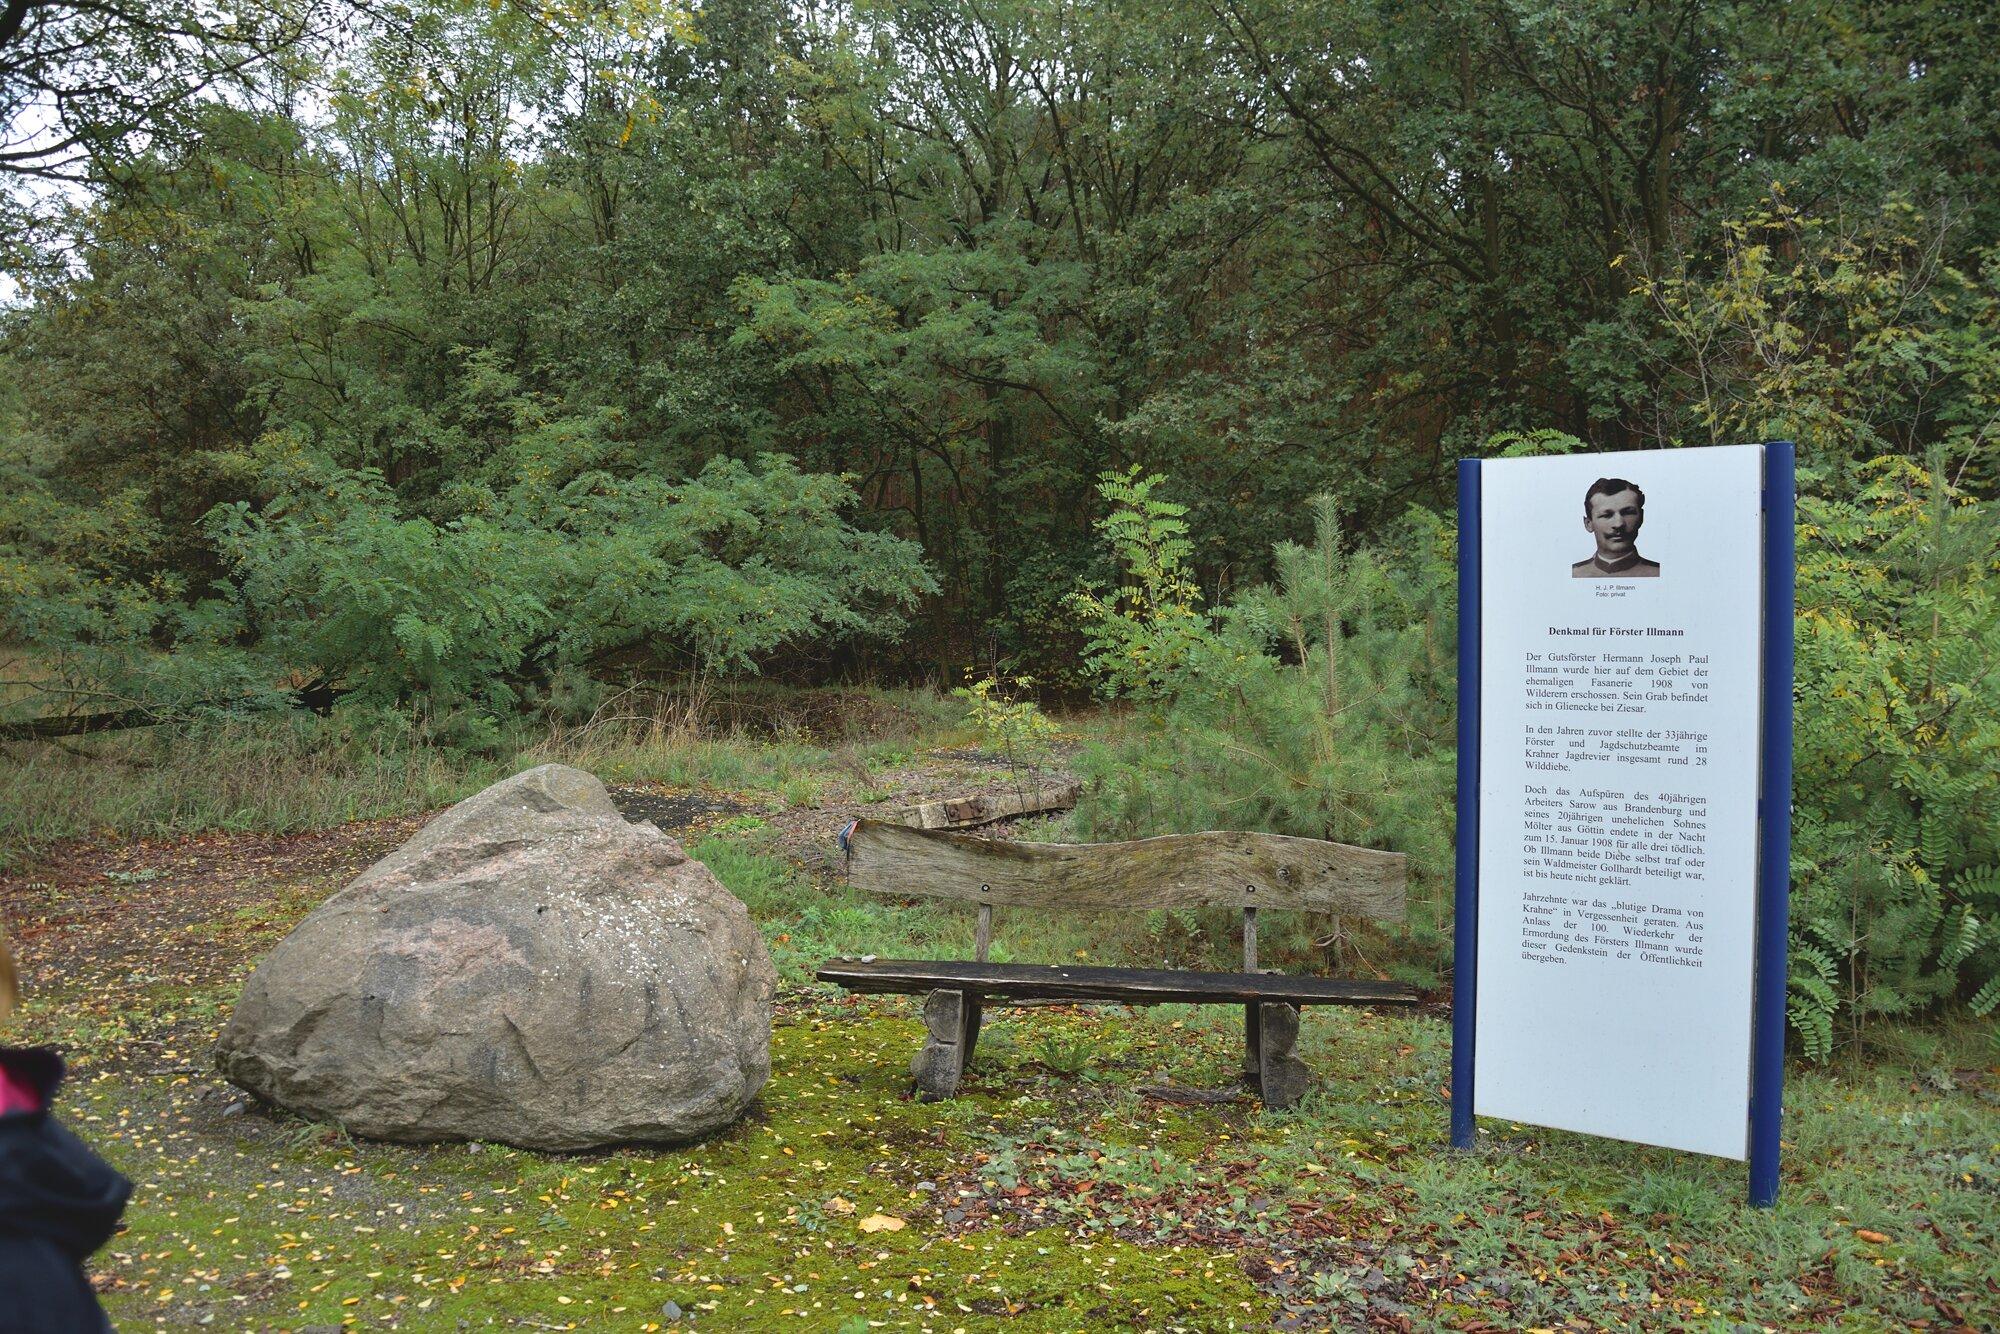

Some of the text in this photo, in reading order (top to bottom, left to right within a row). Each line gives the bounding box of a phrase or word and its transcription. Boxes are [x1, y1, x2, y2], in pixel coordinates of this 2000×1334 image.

[1549, 627, 1684, 636] Denkmal für Förster Illmann
[1526, 653, 1709, 665] Der Gutsförster Hermann Joseph Paul
[1526, 665, 1709, 677] Illmann wurde hier auf dem Gebiet der
[1525, 677, 1574, 688] ehemaligen
[1591, 678, 1633, 688] Fasanerie
[1651, 679, 1673, 688] 1908
[1570, 690, 1620, 700] erschossen.
[1623, 692, 1643, 701] Sein
[1645, 692, 1668, 701] Grab
[1671, 693, 1708, 702] befindet
[1525, 702, 1646, 713] sich in Glienecke bei Ziesar.
[1525, 725, 1708, 742] In den Jahren zuvor stellte der 33jährige
[1525, 737, 1708, 753] Förster und Jagdschutzbeamte im
[1525, 749, 1707, 766] Krahner Jagdrevier insgesamt rund 28
[1525, 785, 1707, 806] Doch das Aufspüren des 40jährigen
[1524, 798, 1706, 817] Arbeiters Sarow aus Brandenburg und
[1524, 810, 1706, 829] seines 20jährigen unehelichen Sohnes
[1524, 821, 1706, 842] Mölter aus Göttin endete in der Nacht
[1523, 834, 1705, 855] zum 15. Januar 1908 für alle drei tödlich.
[1523, 845, 1705, 868] Ob Illmann beide Diebe selbst traf oder
[1523, 857, 1705, 881] sein Waldmeister Gollhardt beteiligt war,
[1523, 869, 1631, 887] ist bis heute nicht geklärt.
[1523, 893, 1567, 904] Jahrzehnte
[1571, 898, 1588, 906] war
[1592, 899, 1607, 908] das
[1652, 905, 1682, 916] Drama
[1687, 910, 1704, 918] von
[1563, 908, 1572, 917] in
[1578, 909, 1638, 924] Vergessenheit
[1644, 917, 1679, 928] geraten.
[1685, 921, 1704, 930] Aus
[1522, 917, 1703, 943] Anlass der 100. Wiederkehr der
[1522, 928, 1703, 955] Ermordung des Försters Illmann wurde
[1521, 952, 1567, 965] übergeben.
[1522, 940, 1703, 968] dieser Gedenkstein der Öffentlichkeit
